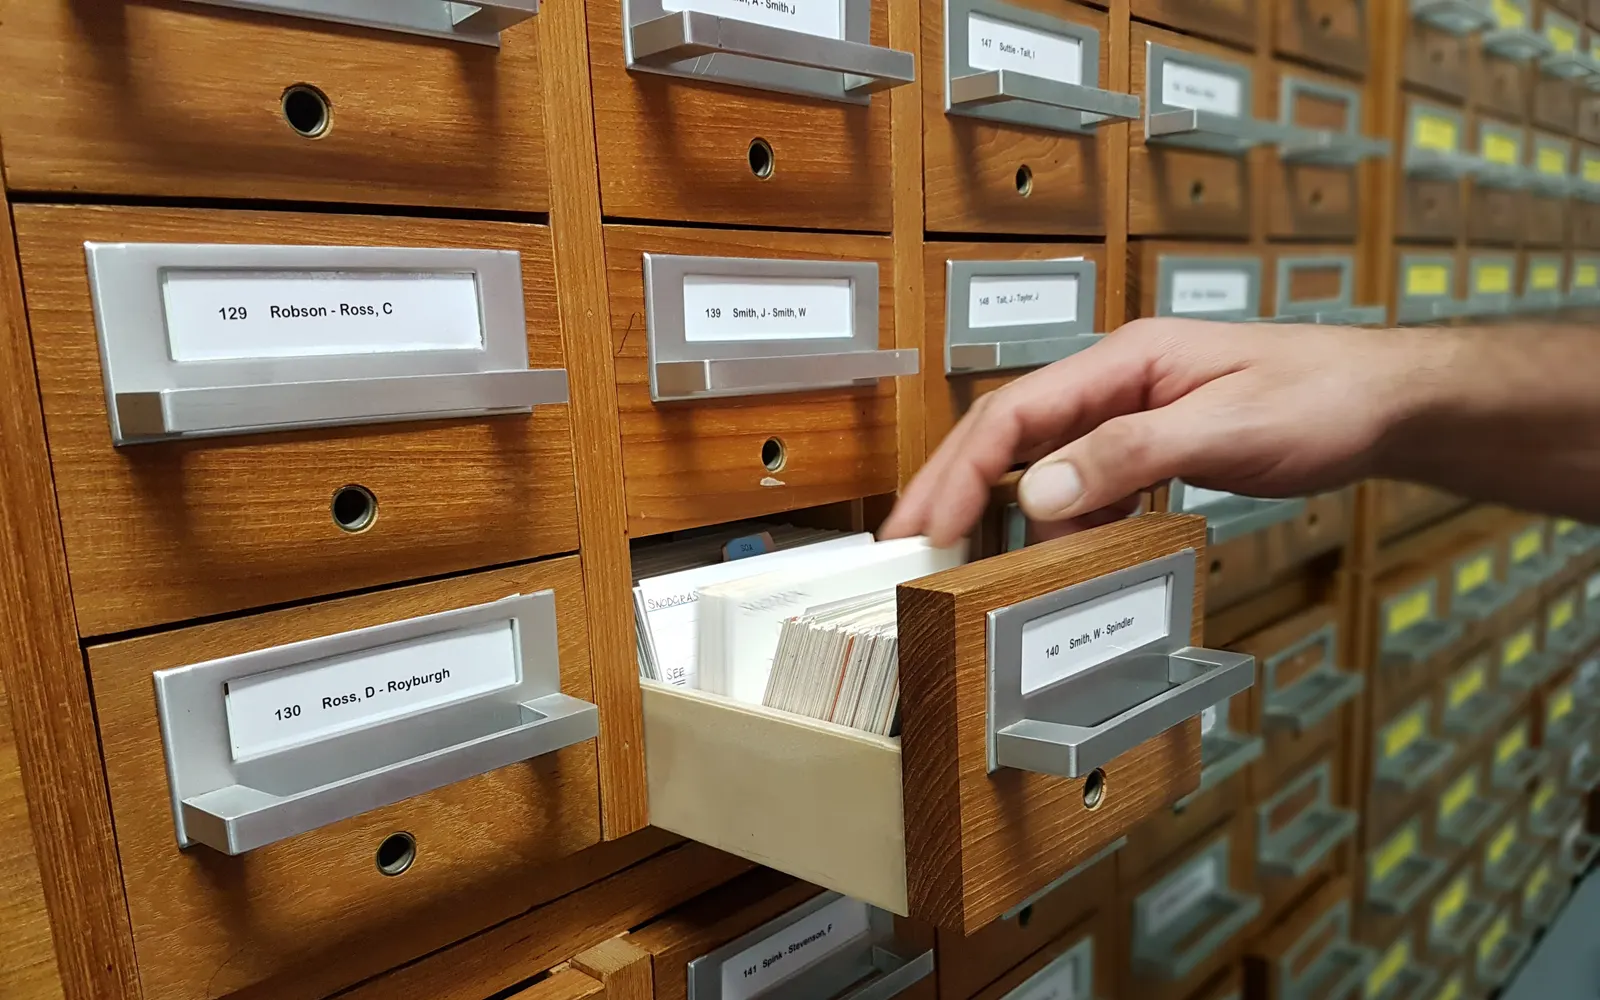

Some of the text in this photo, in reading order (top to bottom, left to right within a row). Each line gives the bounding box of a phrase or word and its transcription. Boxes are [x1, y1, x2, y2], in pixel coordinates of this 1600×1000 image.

[766, 0, 789, 13] Smith
[790, 5, 796, 15] J
[981, 38, 992, 48] 147
[218, 306, 248, 321] 129
[270, 305, 328, 318] Robson
[339, 303, 380, 318] Ross,
[382, 302, 393, 315] C
[705, 307, 721, 319] 139
[732, 307, 759, 319] Smith,
[760, 307, 766, 318] J
[772, 307, 797, 319] Smith,
[798, 307, 807, 317] W
[1045, 644, 1060, 659] 140
[1069, 632, 1092, 650] Smith,
[1093, 627, 1102, 640] W
[1106, 617, 1135, 636] Spindler
[666, 667, 686, 680] SEE
[274, 704, 301, 721] 130
[322, 692, 361, 709] Ross,
[365, 686, 375, 698] D
[387, 668, 451, 693] Royburgh
[743, 964, 757, 978] 141
[762, 951, 783, 968] Spink
[788, 929, 827, 954] Stevenson,
[827, 923, 833, 934] F
